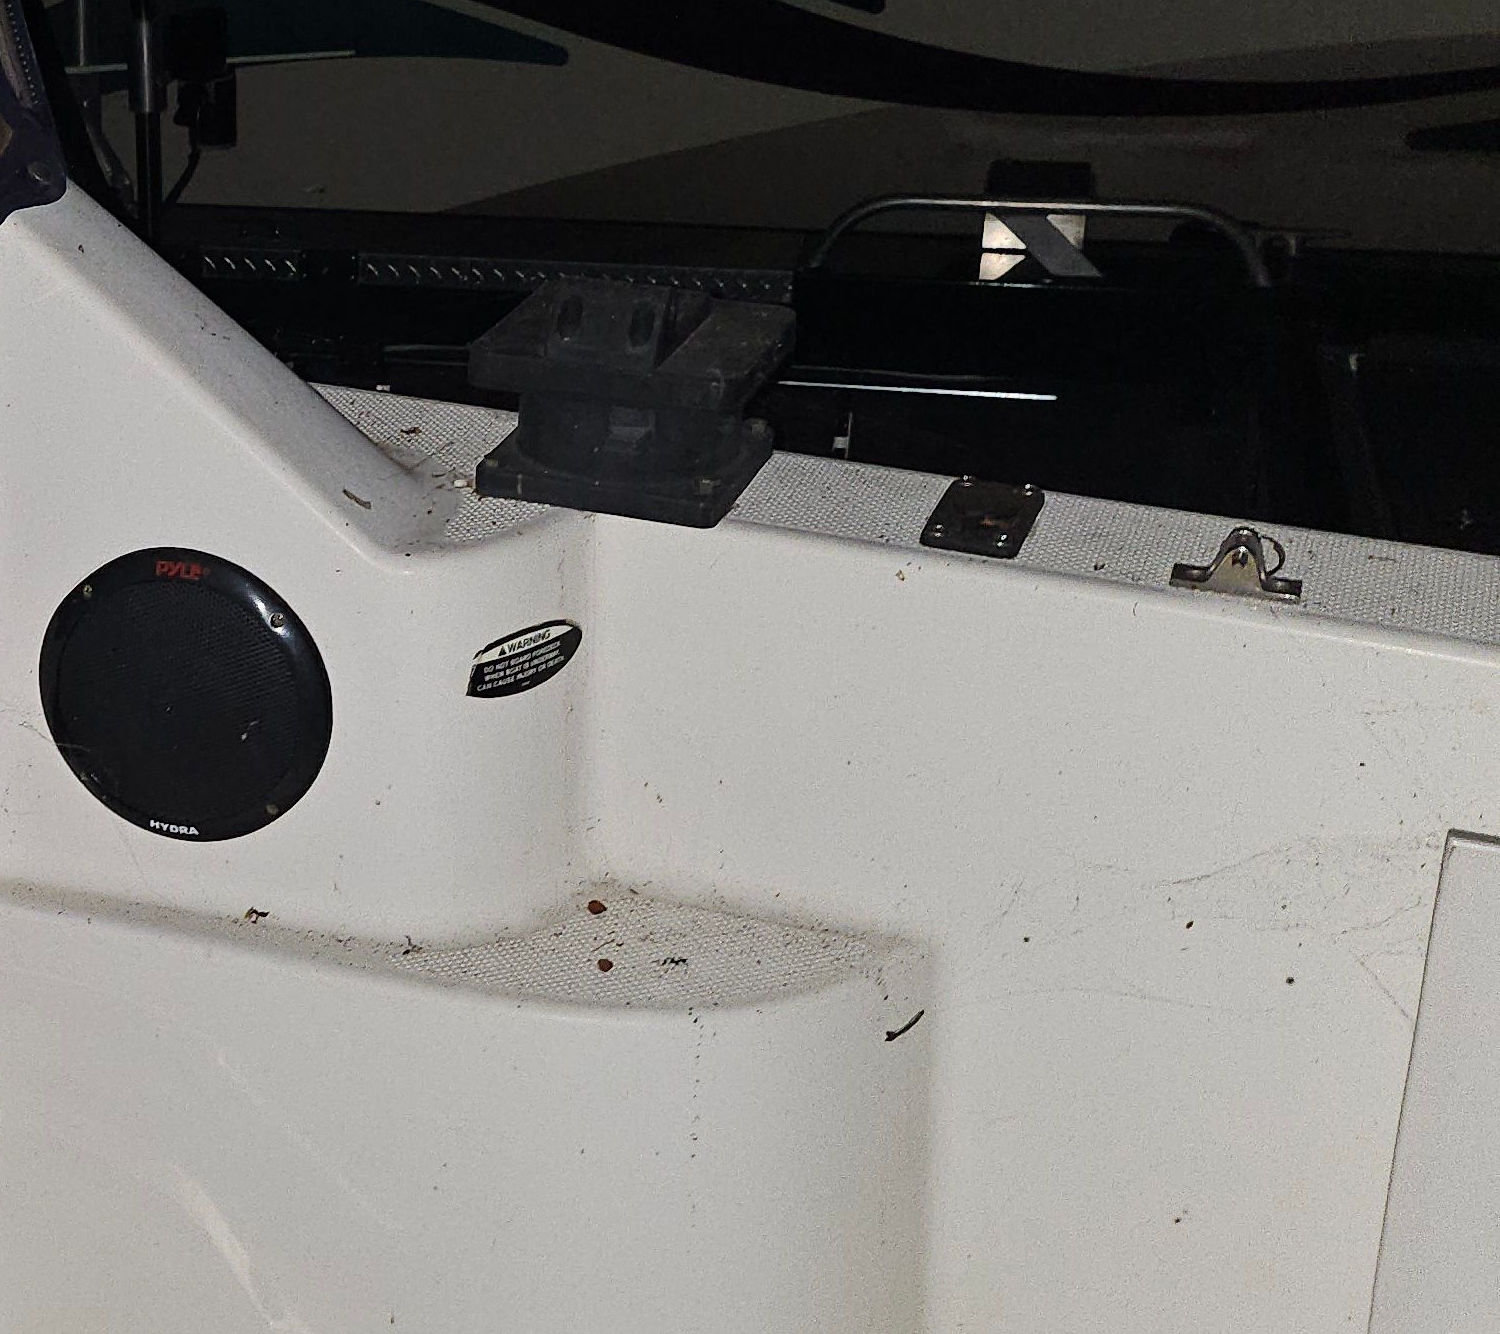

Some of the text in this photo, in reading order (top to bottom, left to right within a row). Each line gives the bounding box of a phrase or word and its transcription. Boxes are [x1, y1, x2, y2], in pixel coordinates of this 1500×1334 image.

[156, 560, 202, 580] PYLE
[508, 629, 551, 653] WARNING
[483, 665, 495, 674] DO
[496, 660, 510, 670] NOT
[477, 682, 493, 692] CAN
[493, 675, 515, 687] CAUSE
[150, 819, 200, 836] HYDRA
